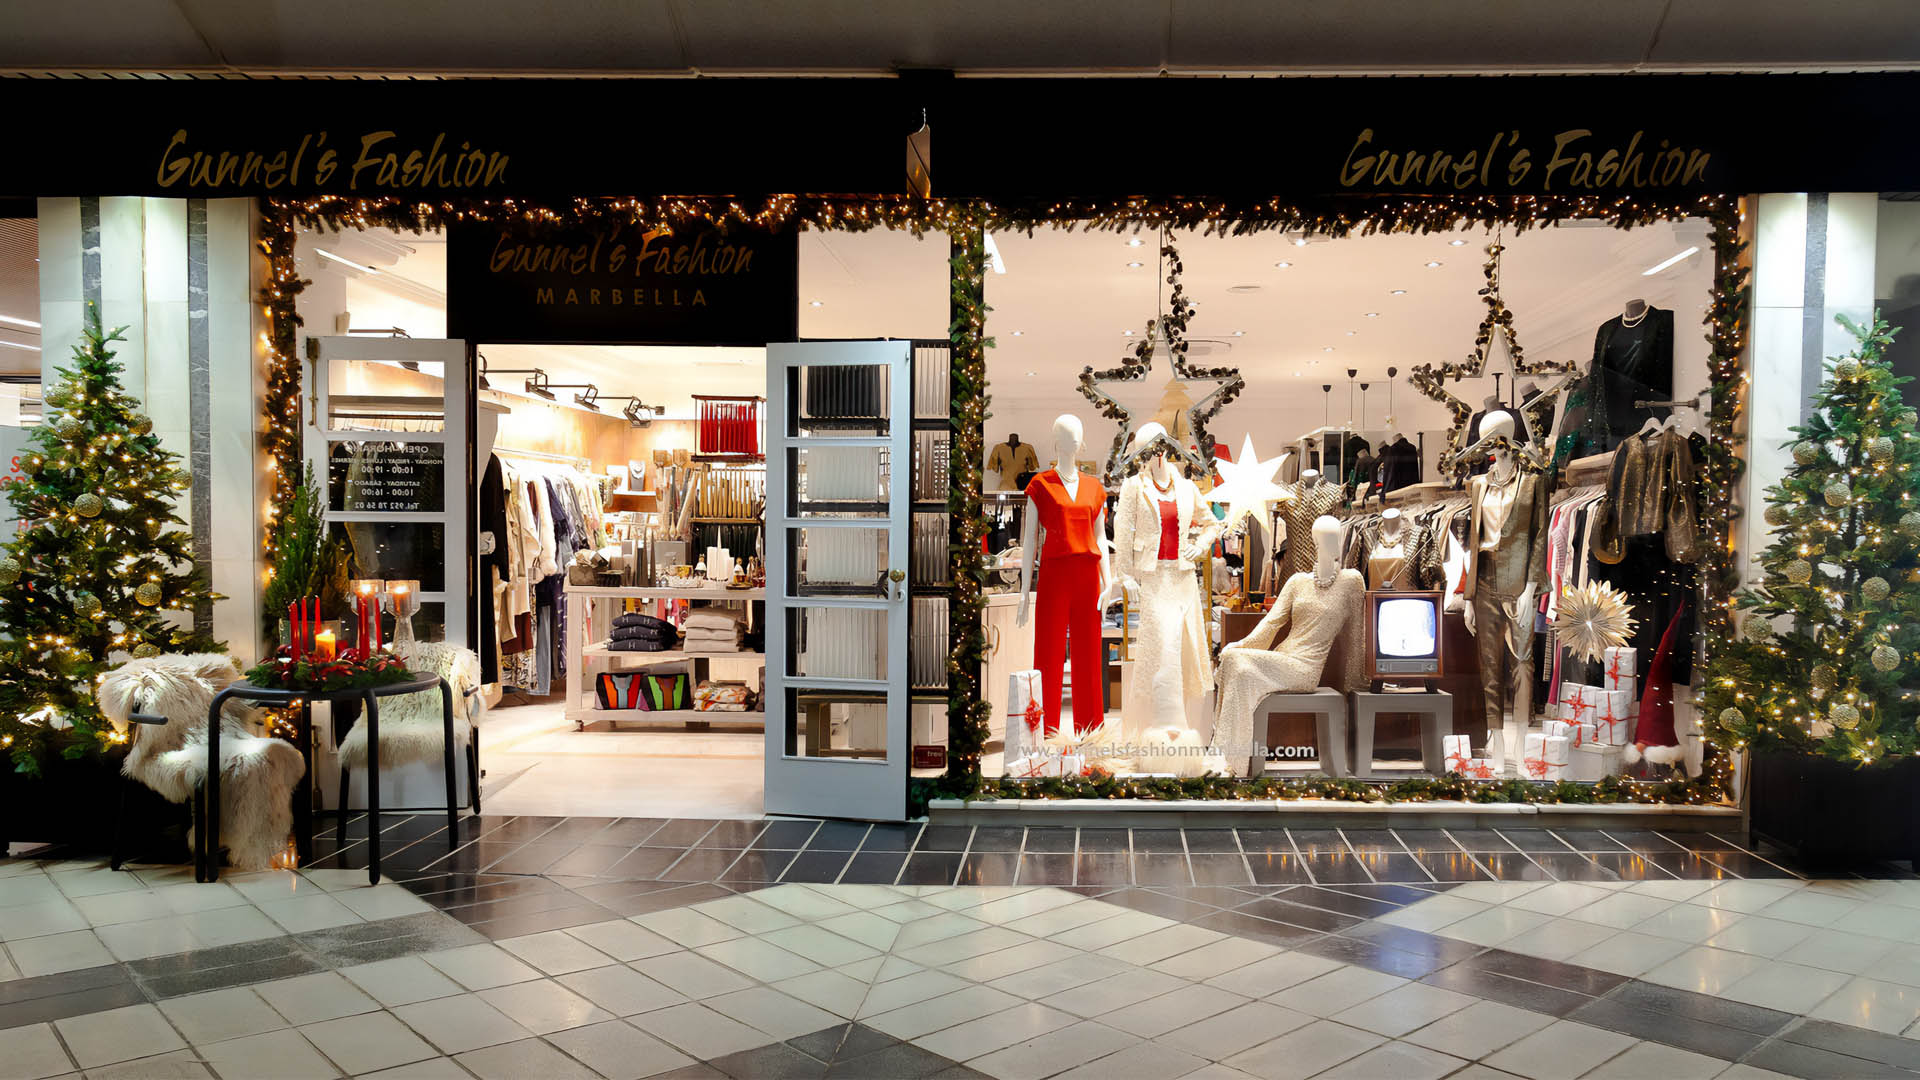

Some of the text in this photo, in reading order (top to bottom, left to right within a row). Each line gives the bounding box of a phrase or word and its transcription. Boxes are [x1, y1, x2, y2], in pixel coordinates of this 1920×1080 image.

[157, 129, 510, 190] Gunnel's Fashion
[1339, 128, 1711, 190] Gunnel's Fashion
[490, 228, 753, 277] Gunnel's Fashion
[536, 288, 707, 306] MARBELLA
[1011, 742, 1315, 760] ww.gnelsfashionmarla.com
